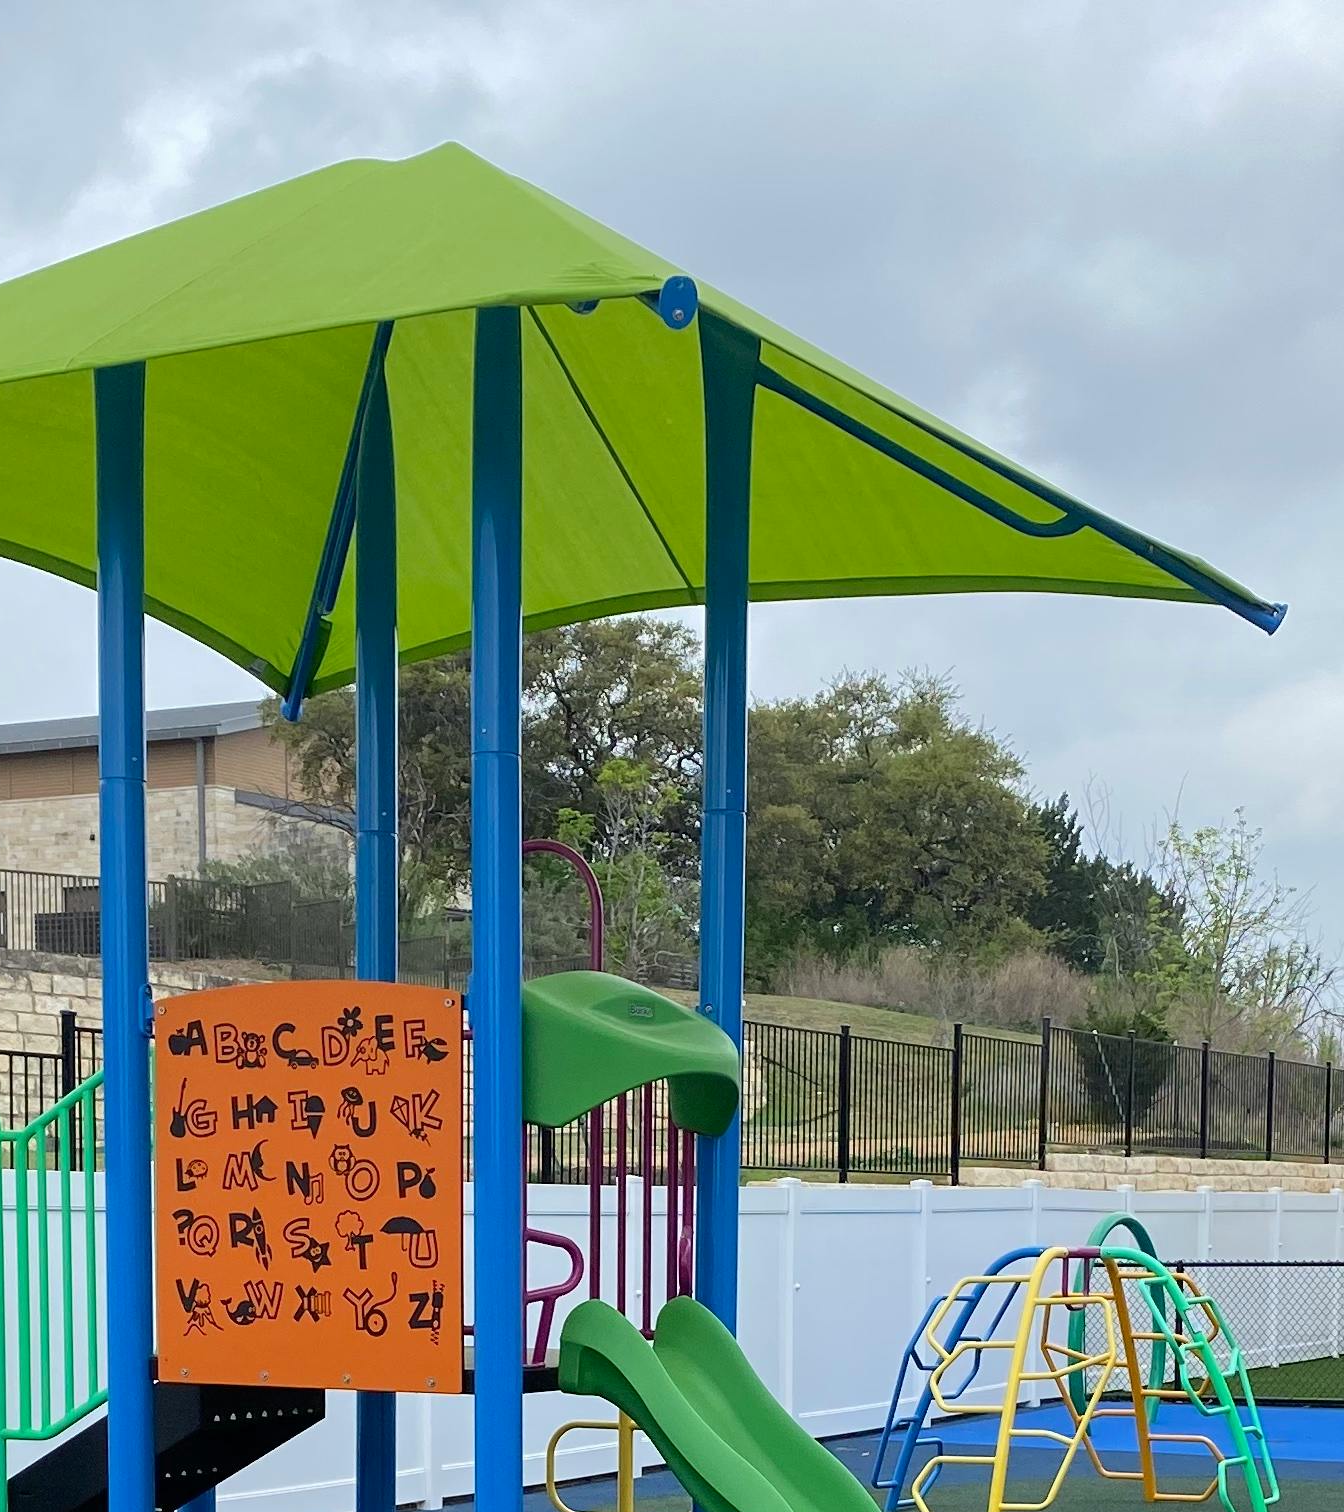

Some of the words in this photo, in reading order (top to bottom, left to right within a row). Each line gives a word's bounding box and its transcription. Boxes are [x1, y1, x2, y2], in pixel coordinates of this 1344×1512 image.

[184, 1020, 208, 1056] A
[214, 1023, 240, 1063] B
[272, 1023, 296, 1059] C
[321, 1026, 350, 1066] D
[375, 1015, 395, 1051] E
[404, 1019, 425, 1058] F
[185, 1099, 218, 1137] G
[231, 1094, 255, 1129] H
[288, 1090, 310, 1130] I
[351, 1101, 377, 1137] J
[412, 1089, 443, 1131] K
[176, 1158, 197, 1191] L
[222, 1151, 259, 1191] M
[286, 1161, 310, 1197] N
[345, 1158, 380, 1201] O
[396, 1161, 423, 1198] P
[187, 1215, 220, 1257] Q
[229, 1212, 255, 1248] R
[283, 1217, 310, 1258] S
[351, 1234, 373, 1270] T
[409, 1229, 439, 1268] U
[175, 1278, 200, 1313] V
[244, 1280, 283, 1319] W
[293, 1284, 320, 1323] X
[342, 1287, 373, 1330] Y
[408, 1292, 434, 1329] Z
